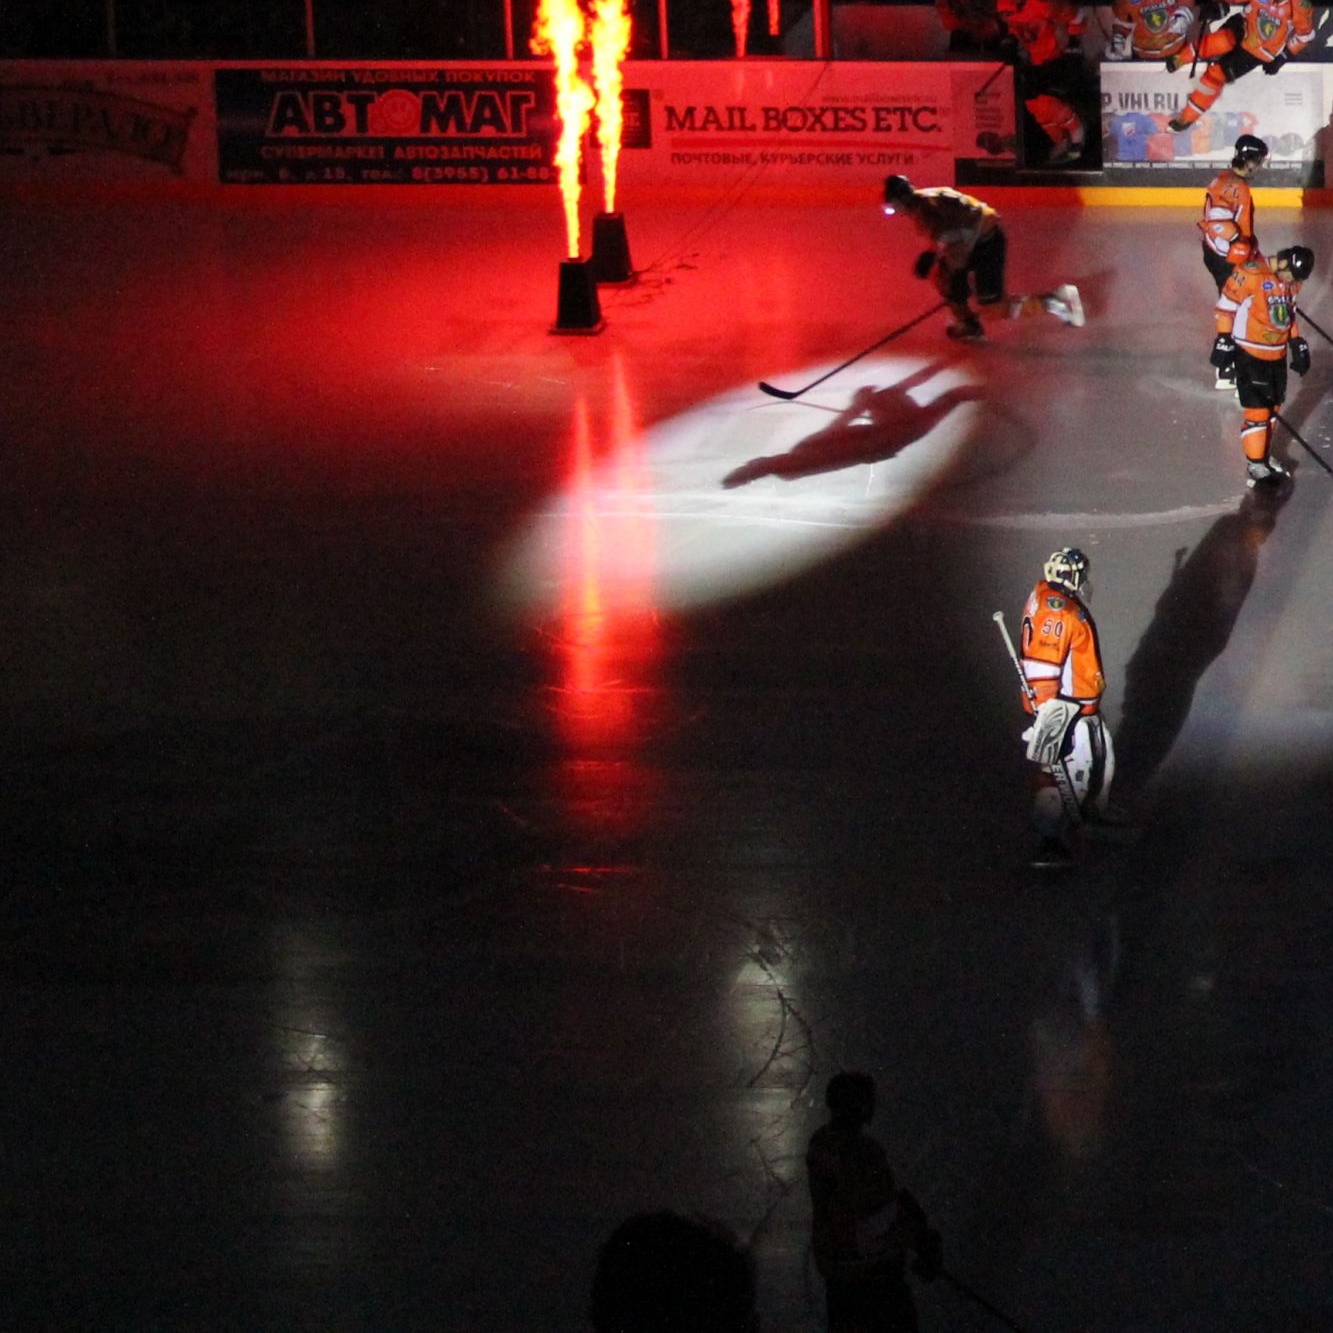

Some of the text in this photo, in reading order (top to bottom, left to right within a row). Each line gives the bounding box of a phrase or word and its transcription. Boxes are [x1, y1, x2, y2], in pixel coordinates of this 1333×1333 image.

[353, 70, 438, 84] УДОБНЫХ
[445, 70, 535, 83] ПОКУПОК
[664, 106, 756, 132] MAIL
[762, 106, 867, 132] BOXES
[873, 106, 942, 132] ETC.
[260, 143, 543, 160] СУПЕРМАРКЕТ АВТОЗАПЧАСТЕЙ
[760, 152, 853, 165] КУРЬЕРСКИЕ
[858, 153, 915, 165] УСЛУГИ
[1042, 618, 1064, 638] 50
